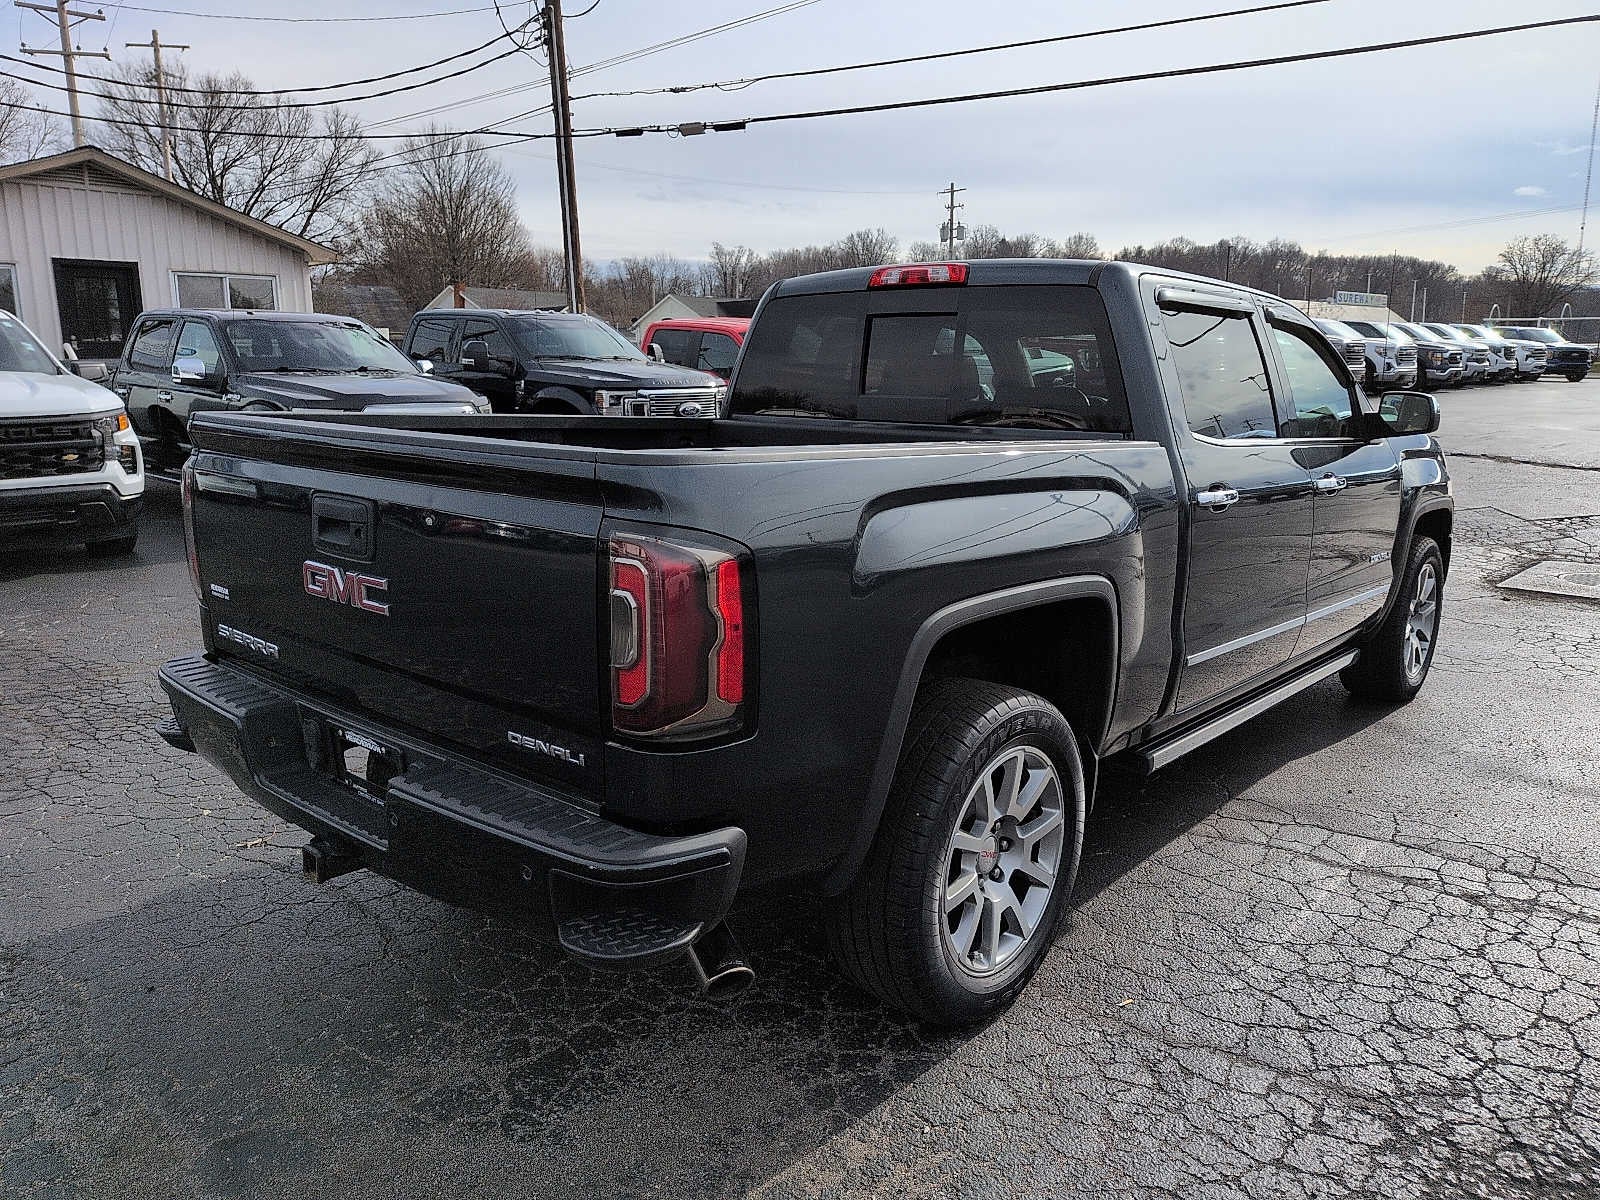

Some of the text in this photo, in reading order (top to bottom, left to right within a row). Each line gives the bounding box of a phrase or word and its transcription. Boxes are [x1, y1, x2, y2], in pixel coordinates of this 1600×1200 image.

[1338, 292, 1375, 304] SUREWAY
[303, 560, 390, 616] GMC
[217, 623, 279, 659] SIERRA
[507, 730, 585, 767] DENALI
